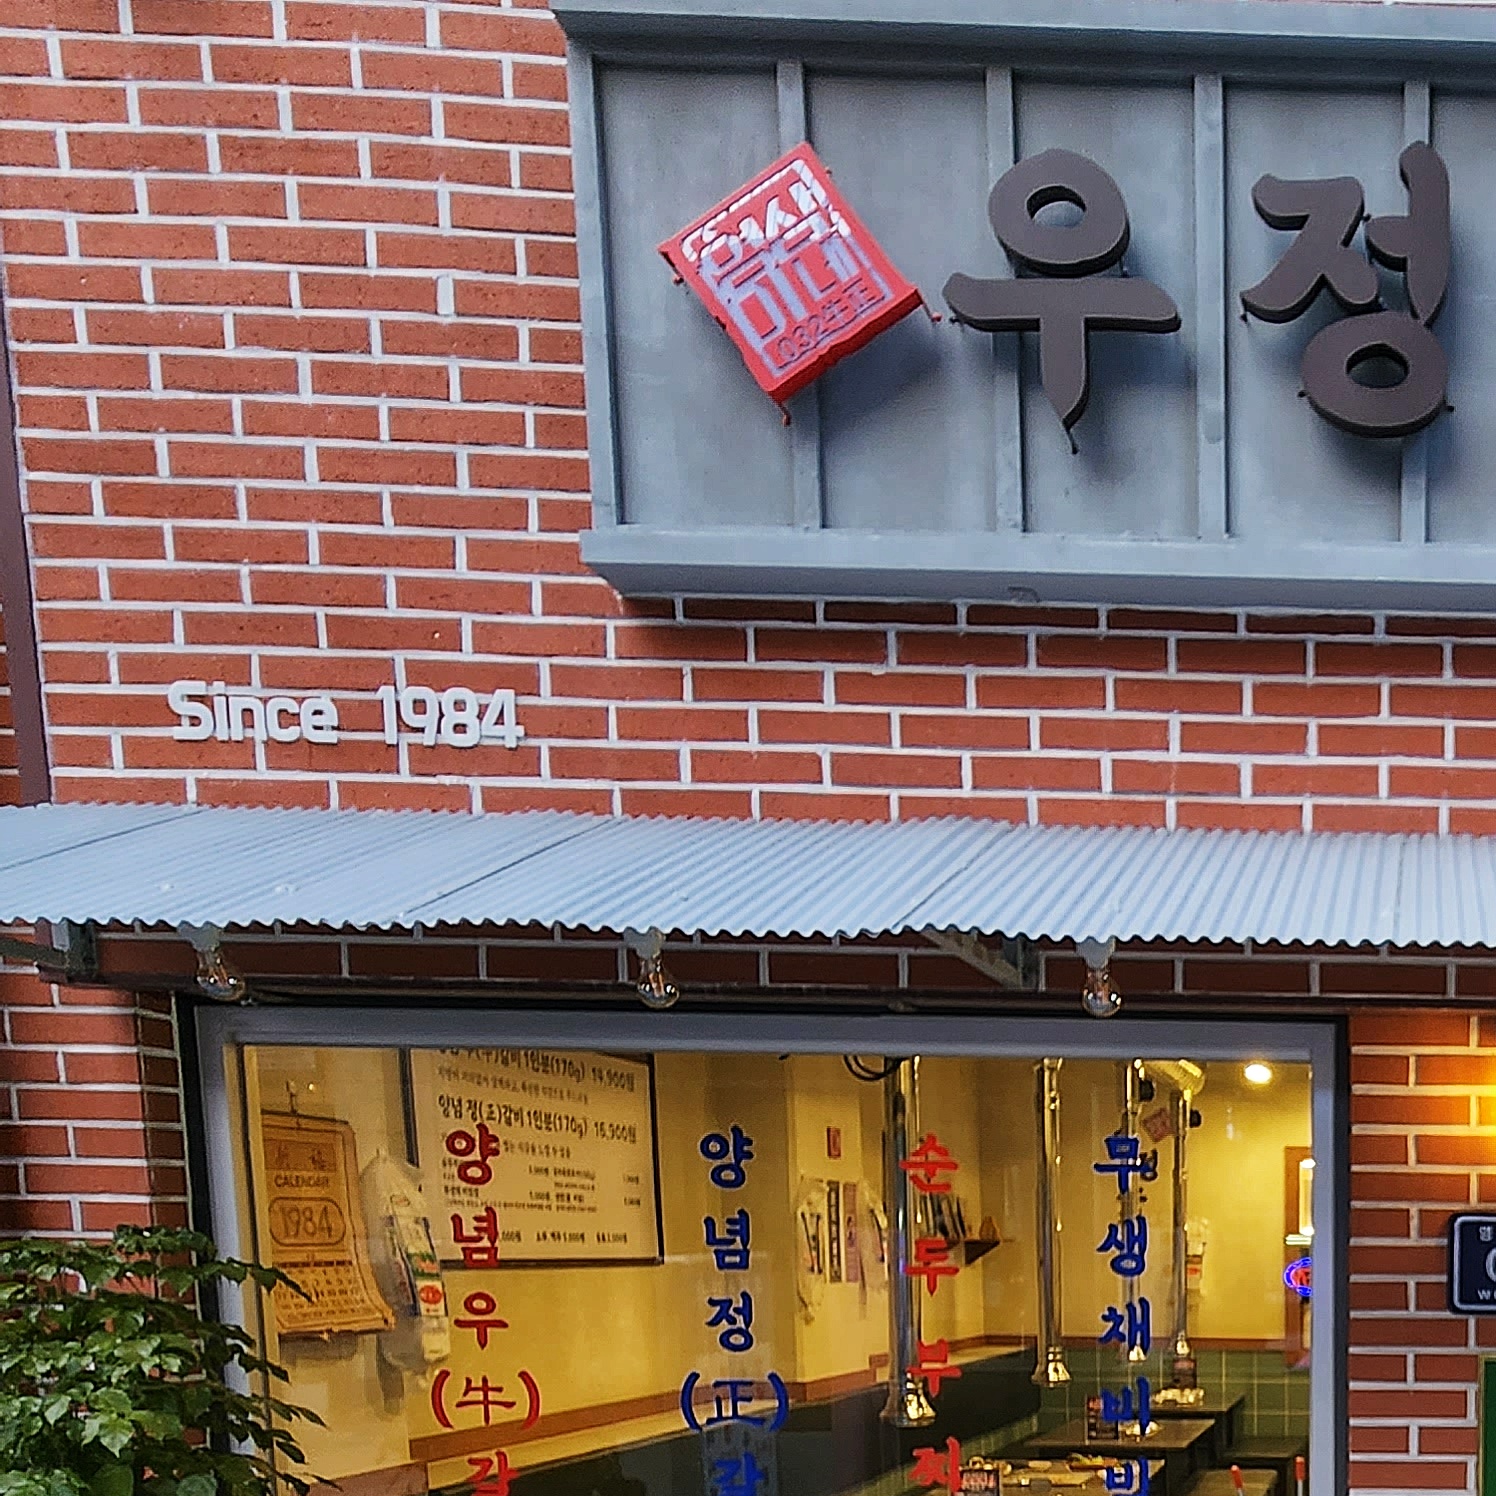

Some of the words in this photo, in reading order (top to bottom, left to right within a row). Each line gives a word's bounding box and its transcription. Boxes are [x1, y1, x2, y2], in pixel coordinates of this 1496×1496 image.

[167, 680, 339, 744] Since
[375, 685, 525, 749] 1984
[281, 1205, 333, 1239] 1984
